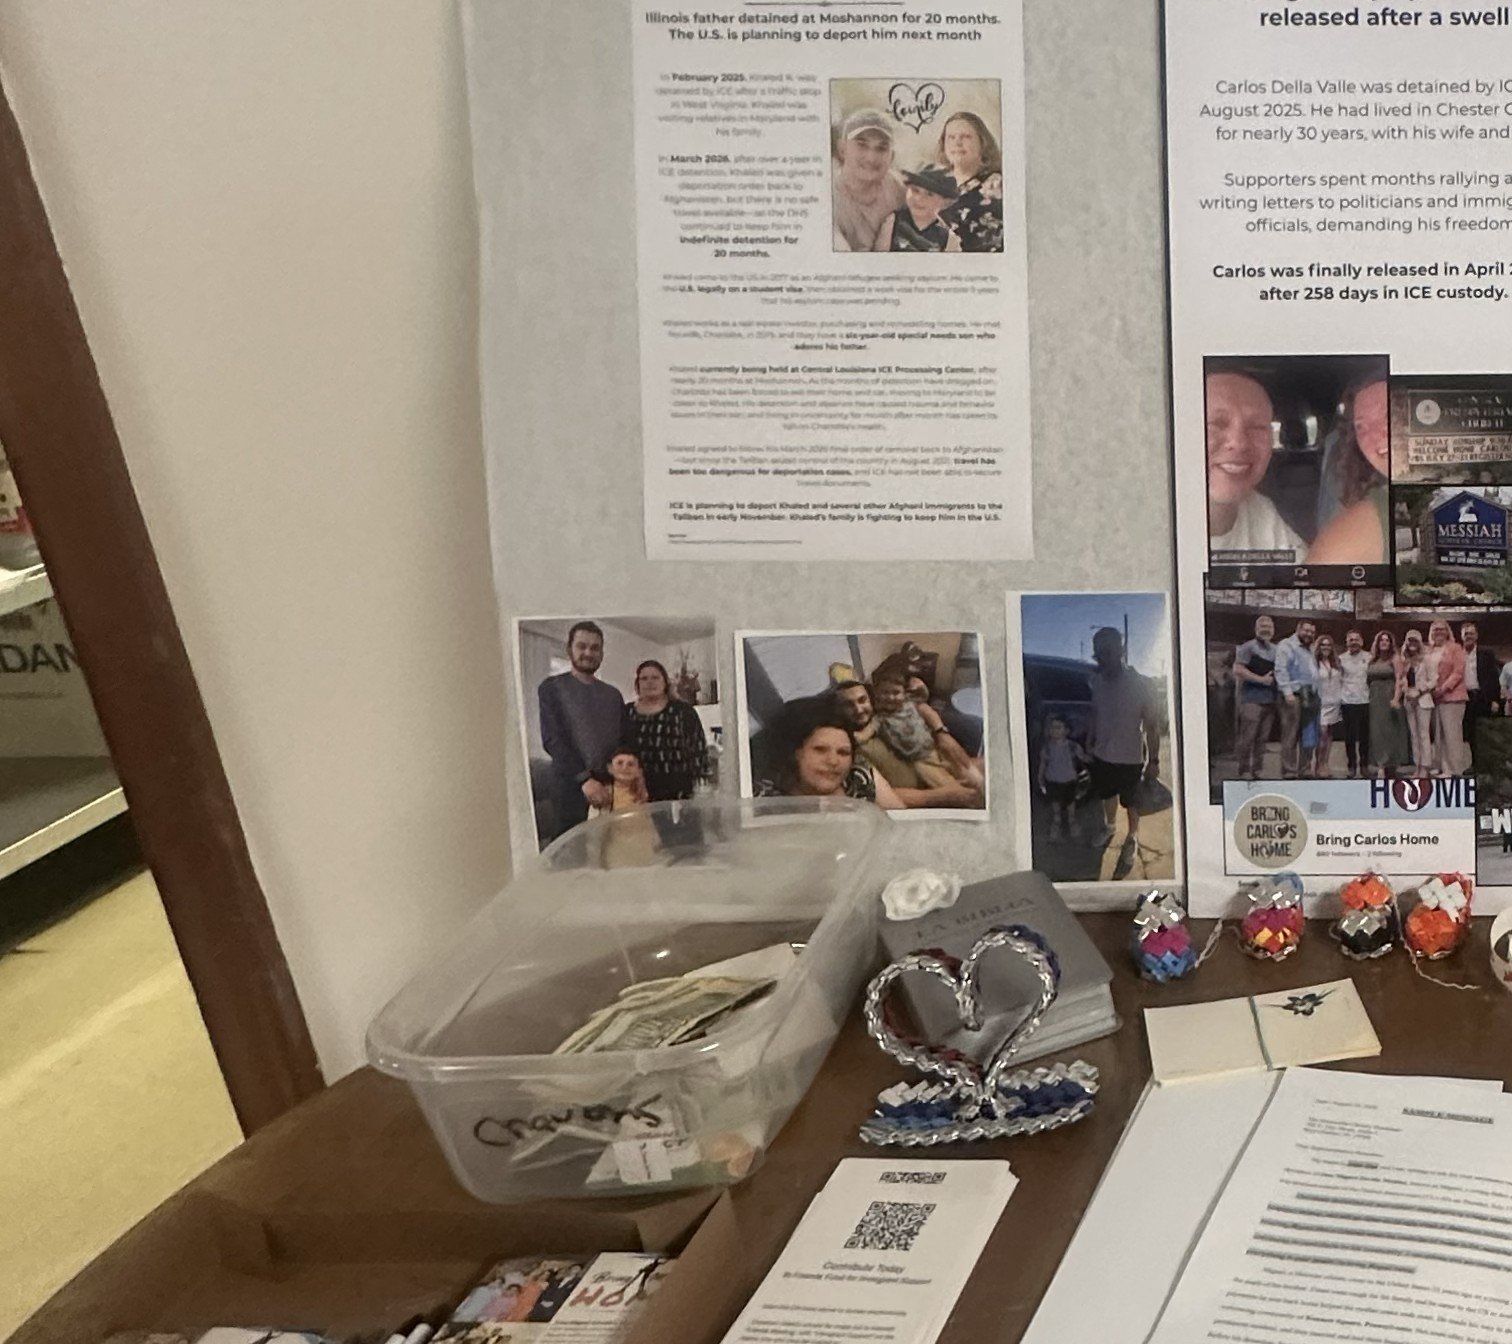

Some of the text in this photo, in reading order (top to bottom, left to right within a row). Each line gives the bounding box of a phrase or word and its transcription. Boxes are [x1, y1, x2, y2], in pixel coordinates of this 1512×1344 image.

[644, 11, 1001, 25] Illinois father detained at Moshannon for 20 months.
[1259, 6, 1359, 27] released
[1366, 6, 1423, 26] after
[1428, 10, 1442, 26] a
[1449, 5, 1509, 26] swell
[667, 27, 694, 40] The
[726, 27, 738, 40] is
[741, 27, 802, 43] planning
[804, 29, 820, 41] to
[822, 27, 868, 42] deport
[870, 26, 898, 40] him
[900, 29, 933, 40] next
[935, 28, 982, 41] month
[1211, 263, 1266, 278] Carlos
[1269, 266, 1304, 278] was
[1307, 261, 1362, 280] finally
[1366, 261, 1439, 277] released
[1443, 260, 1460, 276] in
[1463, 260, 1504, 279] April
[1258, 284, 1509, 303] after 258 days in ICE custody.
[1438, 523, 1502, 538] MESSIAH
[1316, 833, 1439, 847] Bring Carlos Home
